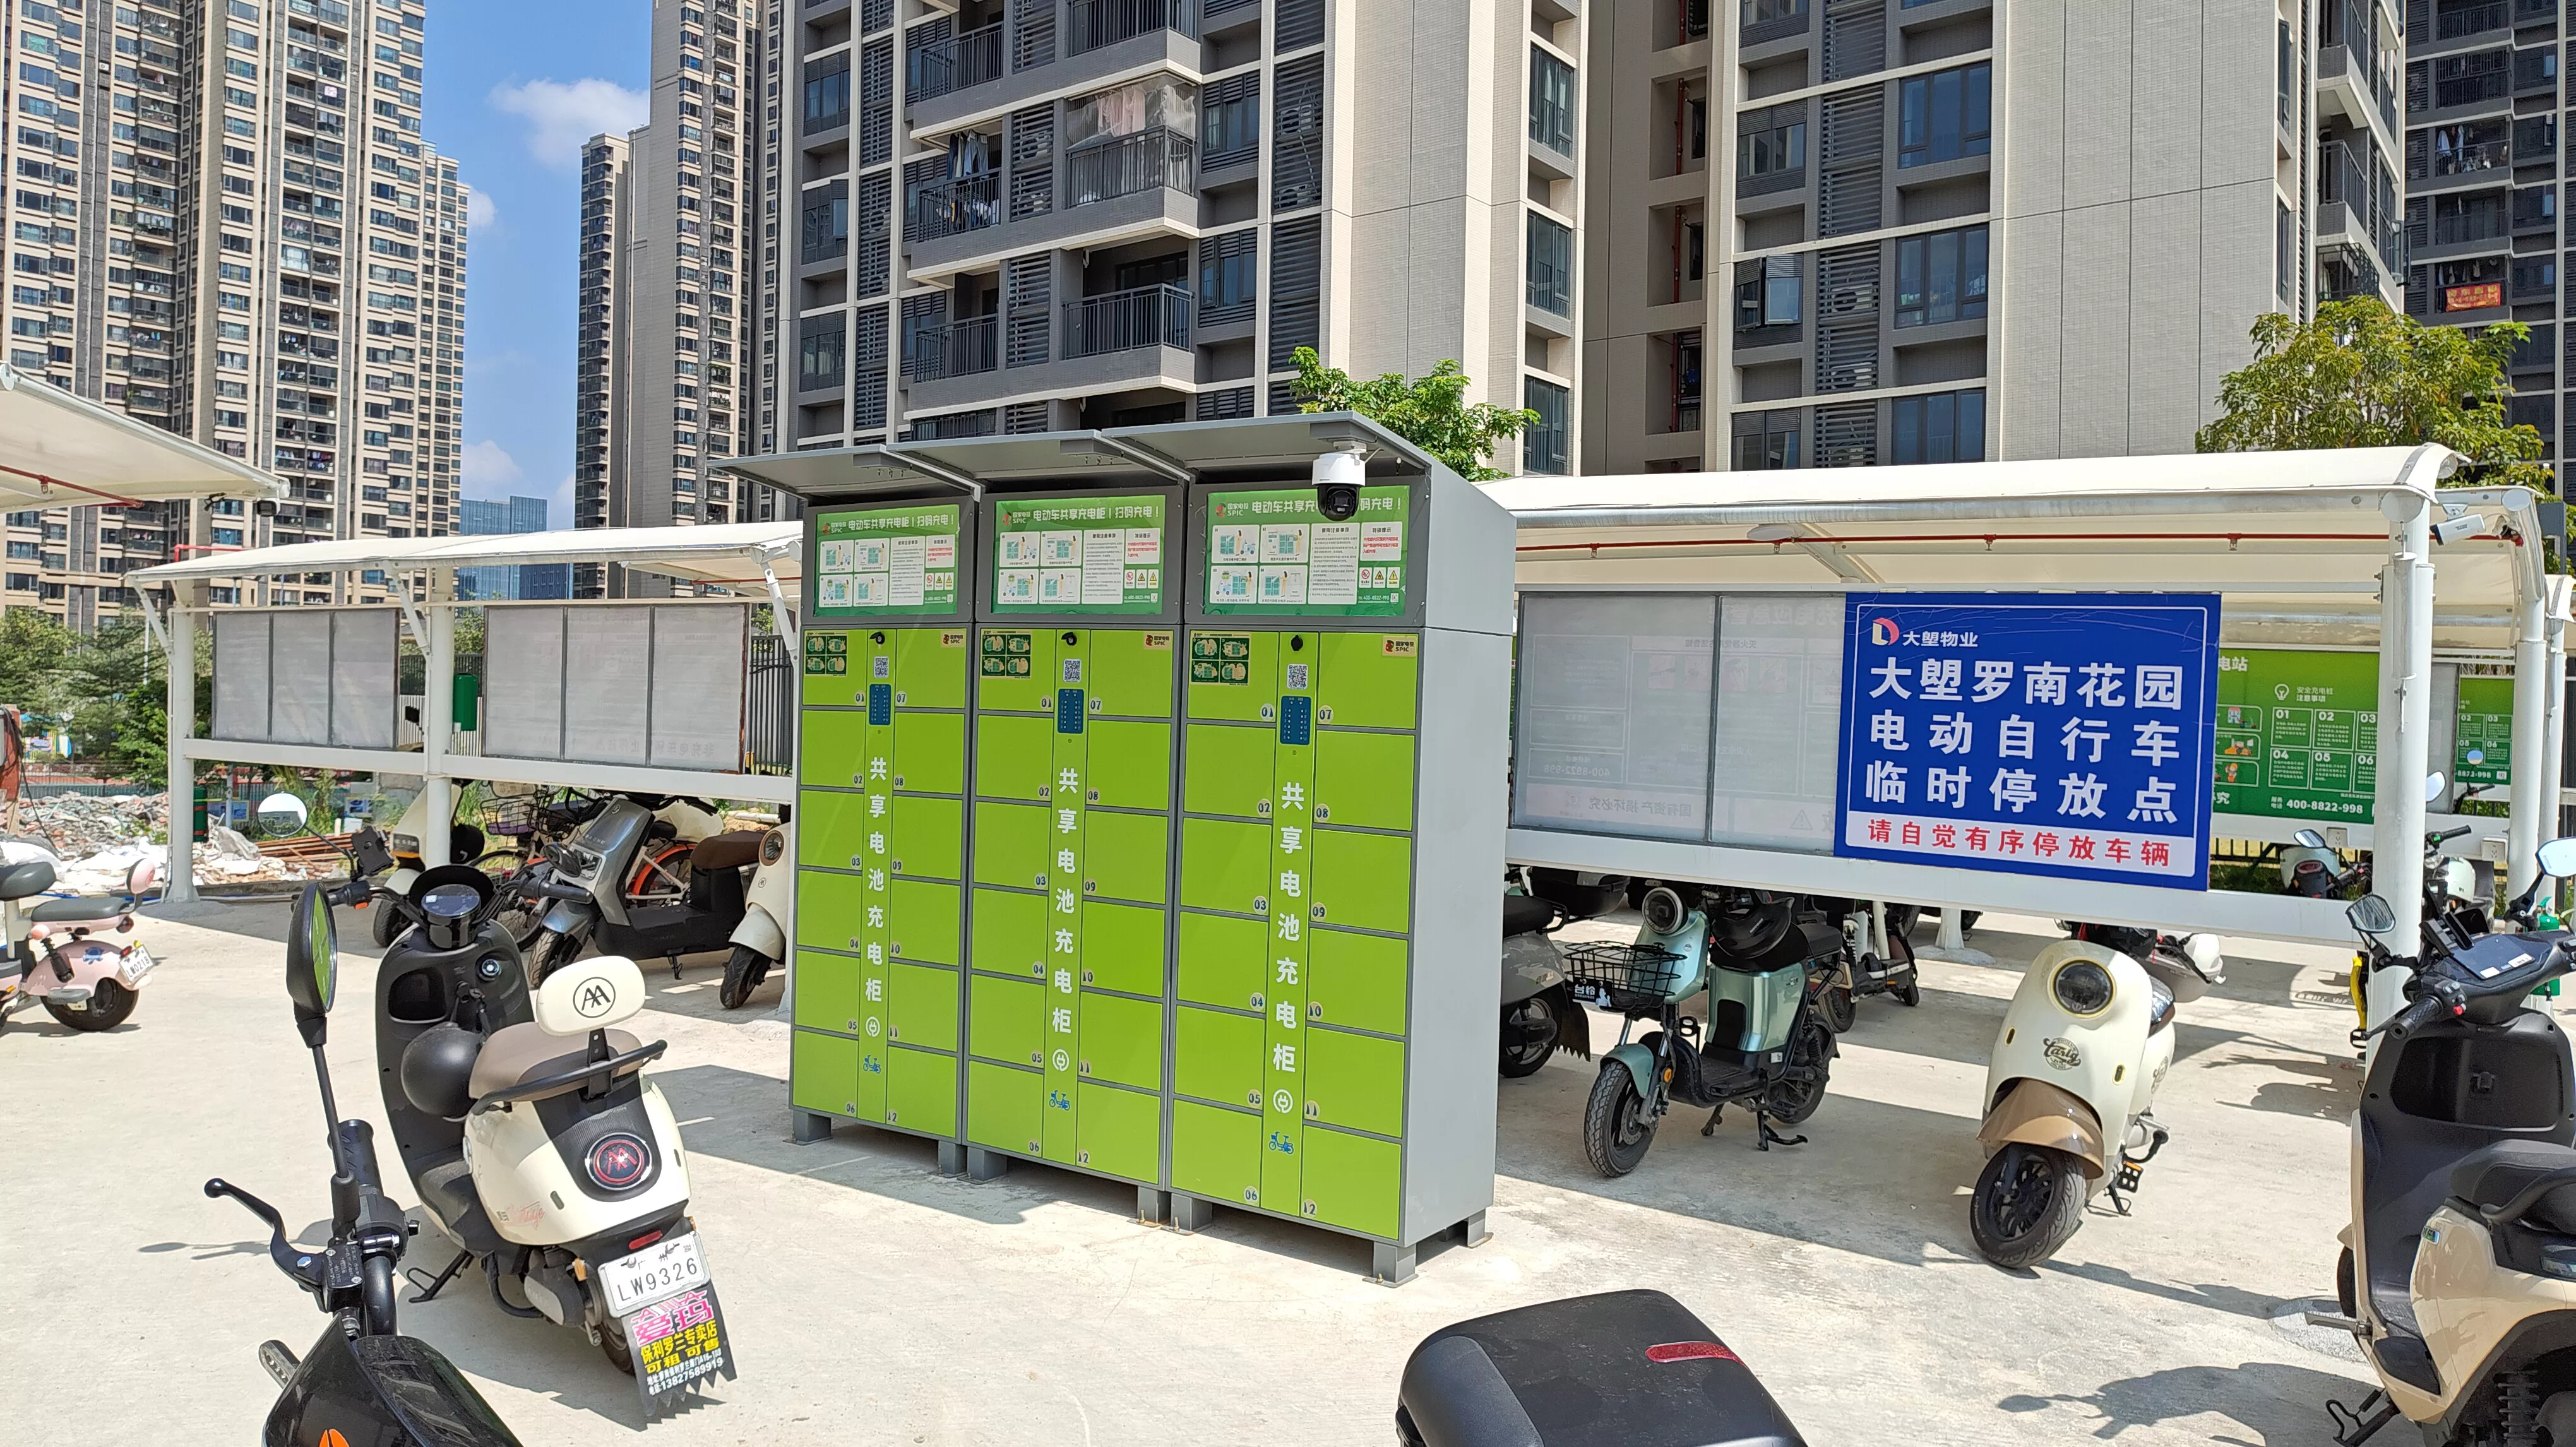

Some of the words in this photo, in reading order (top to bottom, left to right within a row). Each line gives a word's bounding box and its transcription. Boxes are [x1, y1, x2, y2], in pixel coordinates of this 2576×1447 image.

[856, 693, 864, 703] 01
[897, 694, 906, 703] 07
[1041, 698, 1051, 708] 01
[1090, 701, 1101, 710] 07
[1261, 707, 1273, 718] 01
[1320, 710, 1332, 720] 07
[2276, 710, 2289, 719] 01
[2318, 712, 2334, 721] 02
[2360, 713, 2376, 723] 03
[1869, 710, 2179, 767] 电动自行车
[2273, 750, 2289, 759] 04
[2315, 752, 2330, 762] 05
[2358, 755, 2373, 765] 06
[854, 776, 862, 784] 02
[895, 777, 903, 786] 08
[1039, 787, 1049, 797] 02
[1088, 791, 1098, 801] 08
[1865, 760, 2178, 824] 临时停放点
[1258, 803, 1270, 813] 02
[2286, 799, 2363, 814] 400-8822-998
[1316, 807, 1328, 818] 08
[1868, 819, 2170, 867] 请自觉有序停放车辆
[852, 857, 860, 866] 03
[893, 861, 902, 870] 09
[865, 756, 887, 1003] 共享电池充电柜
[1035, 876, 1046, 885] 03
[1085, 881, 1095, 891] 09
[1052, 767, 1078, 1033] 共享电池充电柜
[1254, 900, 1267, 910] 03
[1313, 907, 1325, 917] 09
[1272, 781, 1304, 1073] 共享电池充电柜
[850, 939, 859, 948] 04
[891, 944, 900, 953] 10
[1034, 965, 1044, 974] 04
[1082, 972, 1093, 982] 10
[1251, 997, 1263, 1007] 04
[1309, 1006, 1321, 1016] 10
[848, 1021, 857, 1030] 05
[890, 1028, 898, 1037] 11
[1032, 1053, 1042, 1063] 05
[1080, 1063, 1090, 1073] 11
[1248, 1093, 1261, 1104] 05
[846, 1104, 855, 1113] 06
[1306, 1105, 1318, 1116] 11
[888, 1112, 897, 1122] 12
[1029, 1142, 1039, 1152] 06
[1078, 1153, 1088, 1163] 12
[1245, 1189, 1258, 1200] 06
[1304, 1203, 1316, 1215] 12
[617, 1258, 697, 1302] LW9326
[640, 1319, 717, 1364] 保利罗兰专卖店
[645, 1352, 681, 1374] 可租
[685, 1337, 720, 1357] 可售
